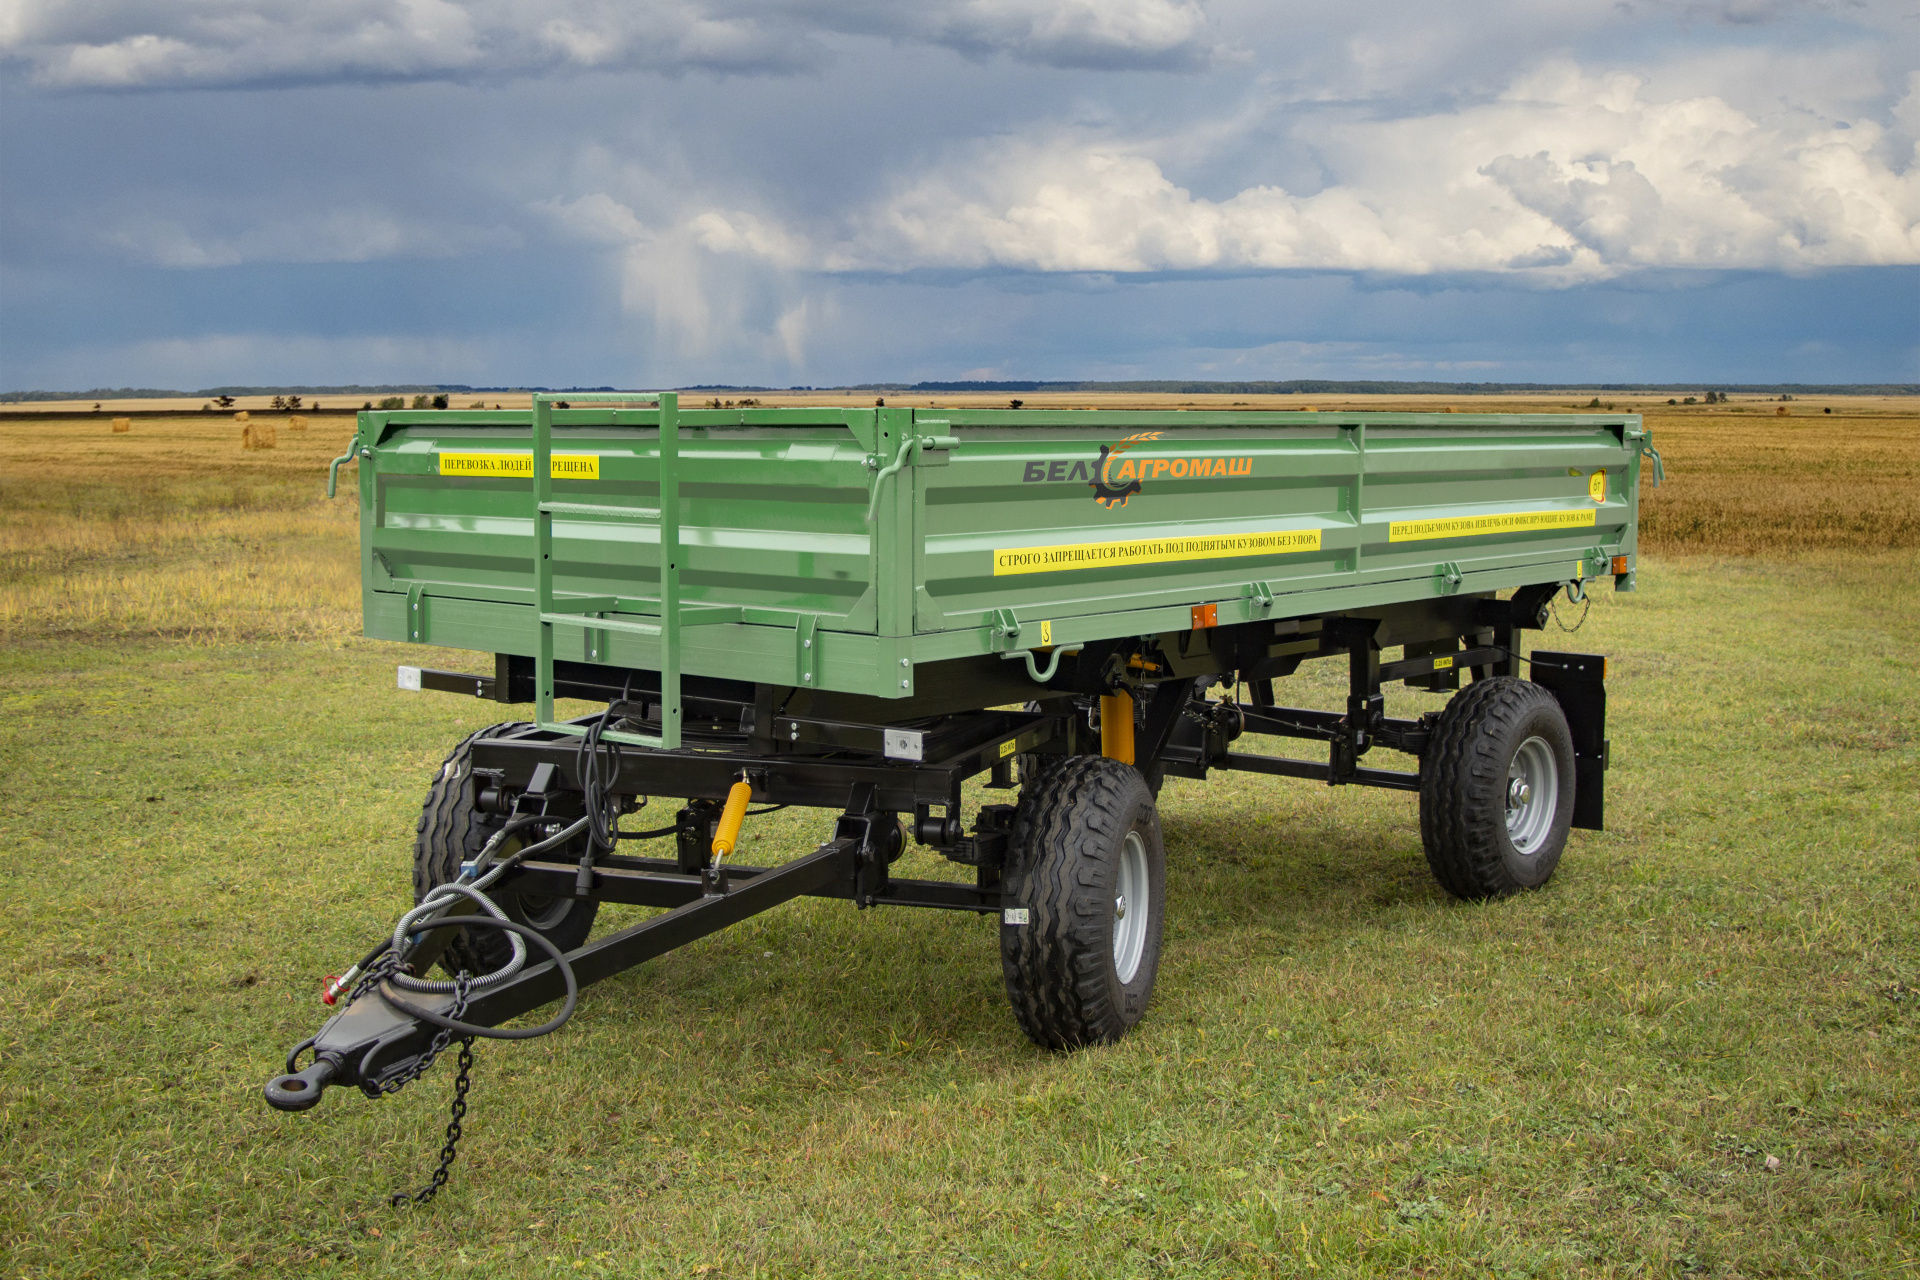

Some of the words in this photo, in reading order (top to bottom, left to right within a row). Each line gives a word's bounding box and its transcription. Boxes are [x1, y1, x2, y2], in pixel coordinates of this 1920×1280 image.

[444, 459, 495, 470] ПЕРЕВОЗКА
[497, 458, 532, 471] ЛЮДЕЙ
[552, 461, 594, 473] РЕЩЕНА
[1023, 460, 1089, 483] БЕЛ
[1116, 457, 1253, 480] АГРОМАШ
[1392, 525, 1413, 536] ПЕРЕД
[1414, 522, 1451, 534] ПОДЪЕМОМ
[1451, 520, 1474, 531] КУЗОВА
[1501, 517, 1514, 527] ОСИ
[999, 553, 1041, 567] СТРОГО
[1043, 547, 1116, 564] ЗАПРЕЩАЕТСЯ
[1118, 543, 1164, 558] РАБОТАТЬ
[1165, 542, 1184, 554] ПОД
[1186, 539, 1236, 553] ПОДНЯТЫМ
[1237, 536, 1276, 549] КУЗОВОМ
[1277, 536, 1292, 546] БЕЗ
[1292, 534, 1318, 545] УПОРА
